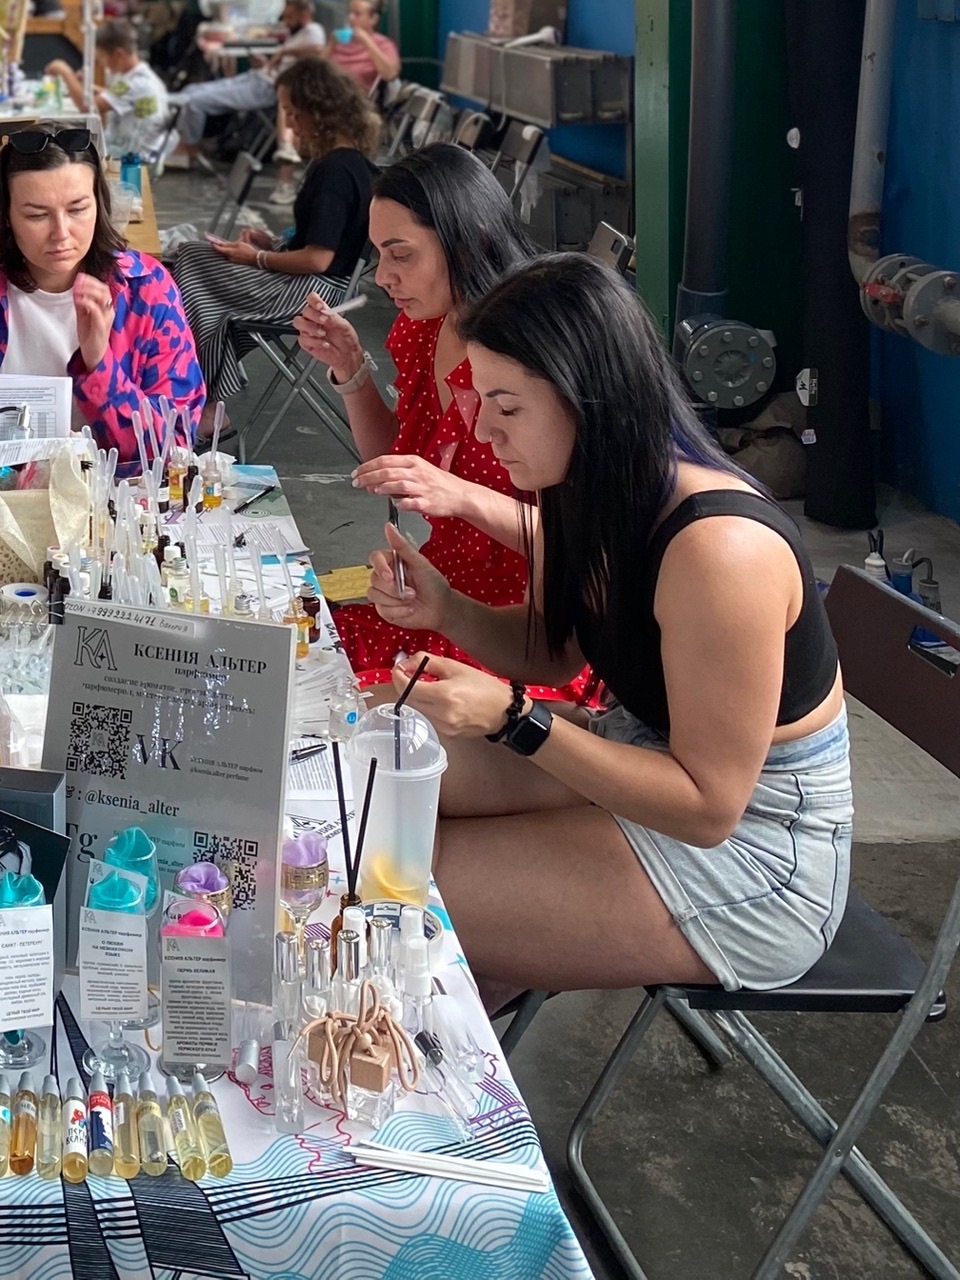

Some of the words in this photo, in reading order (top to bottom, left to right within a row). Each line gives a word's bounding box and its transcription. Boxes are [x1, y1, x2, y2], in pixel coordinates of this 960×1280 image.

[134, 643, 199, 666] КСЕНИЯ
[205, 653, 268, 675] АЛЬТЕР
[174, 666, 228, 681] парфюмер
[135, 733, 182, 770] VK
[85, 789, 180, 817] @ksenia_alter
